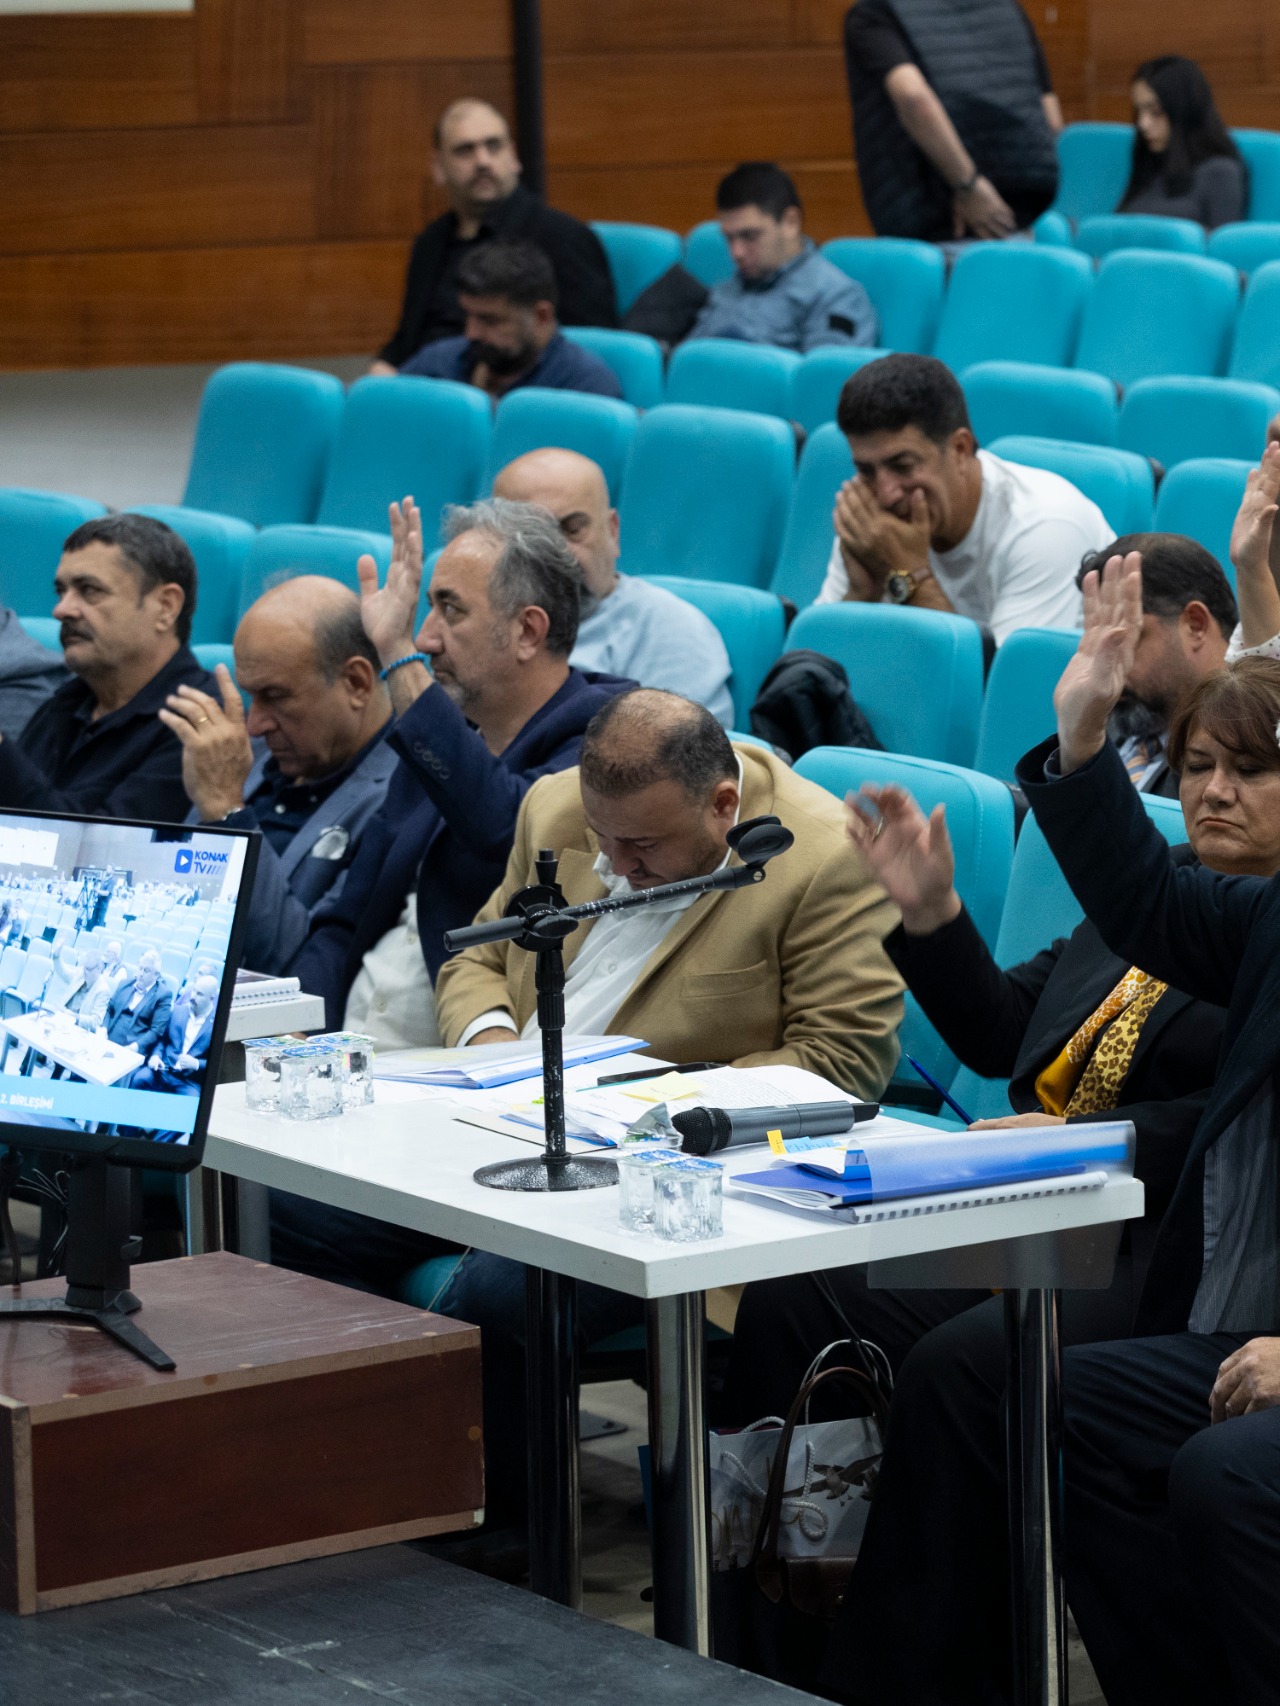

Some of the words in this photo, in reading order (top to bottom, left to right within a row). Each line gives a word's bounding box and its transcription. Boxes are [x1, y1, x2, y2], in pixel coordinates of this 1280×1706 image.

[194, 850, 229, 863] KONAK
[194, 861, 207, 874] TV
[9, 1092, 54, 1110] BİRLEŞİMİ
